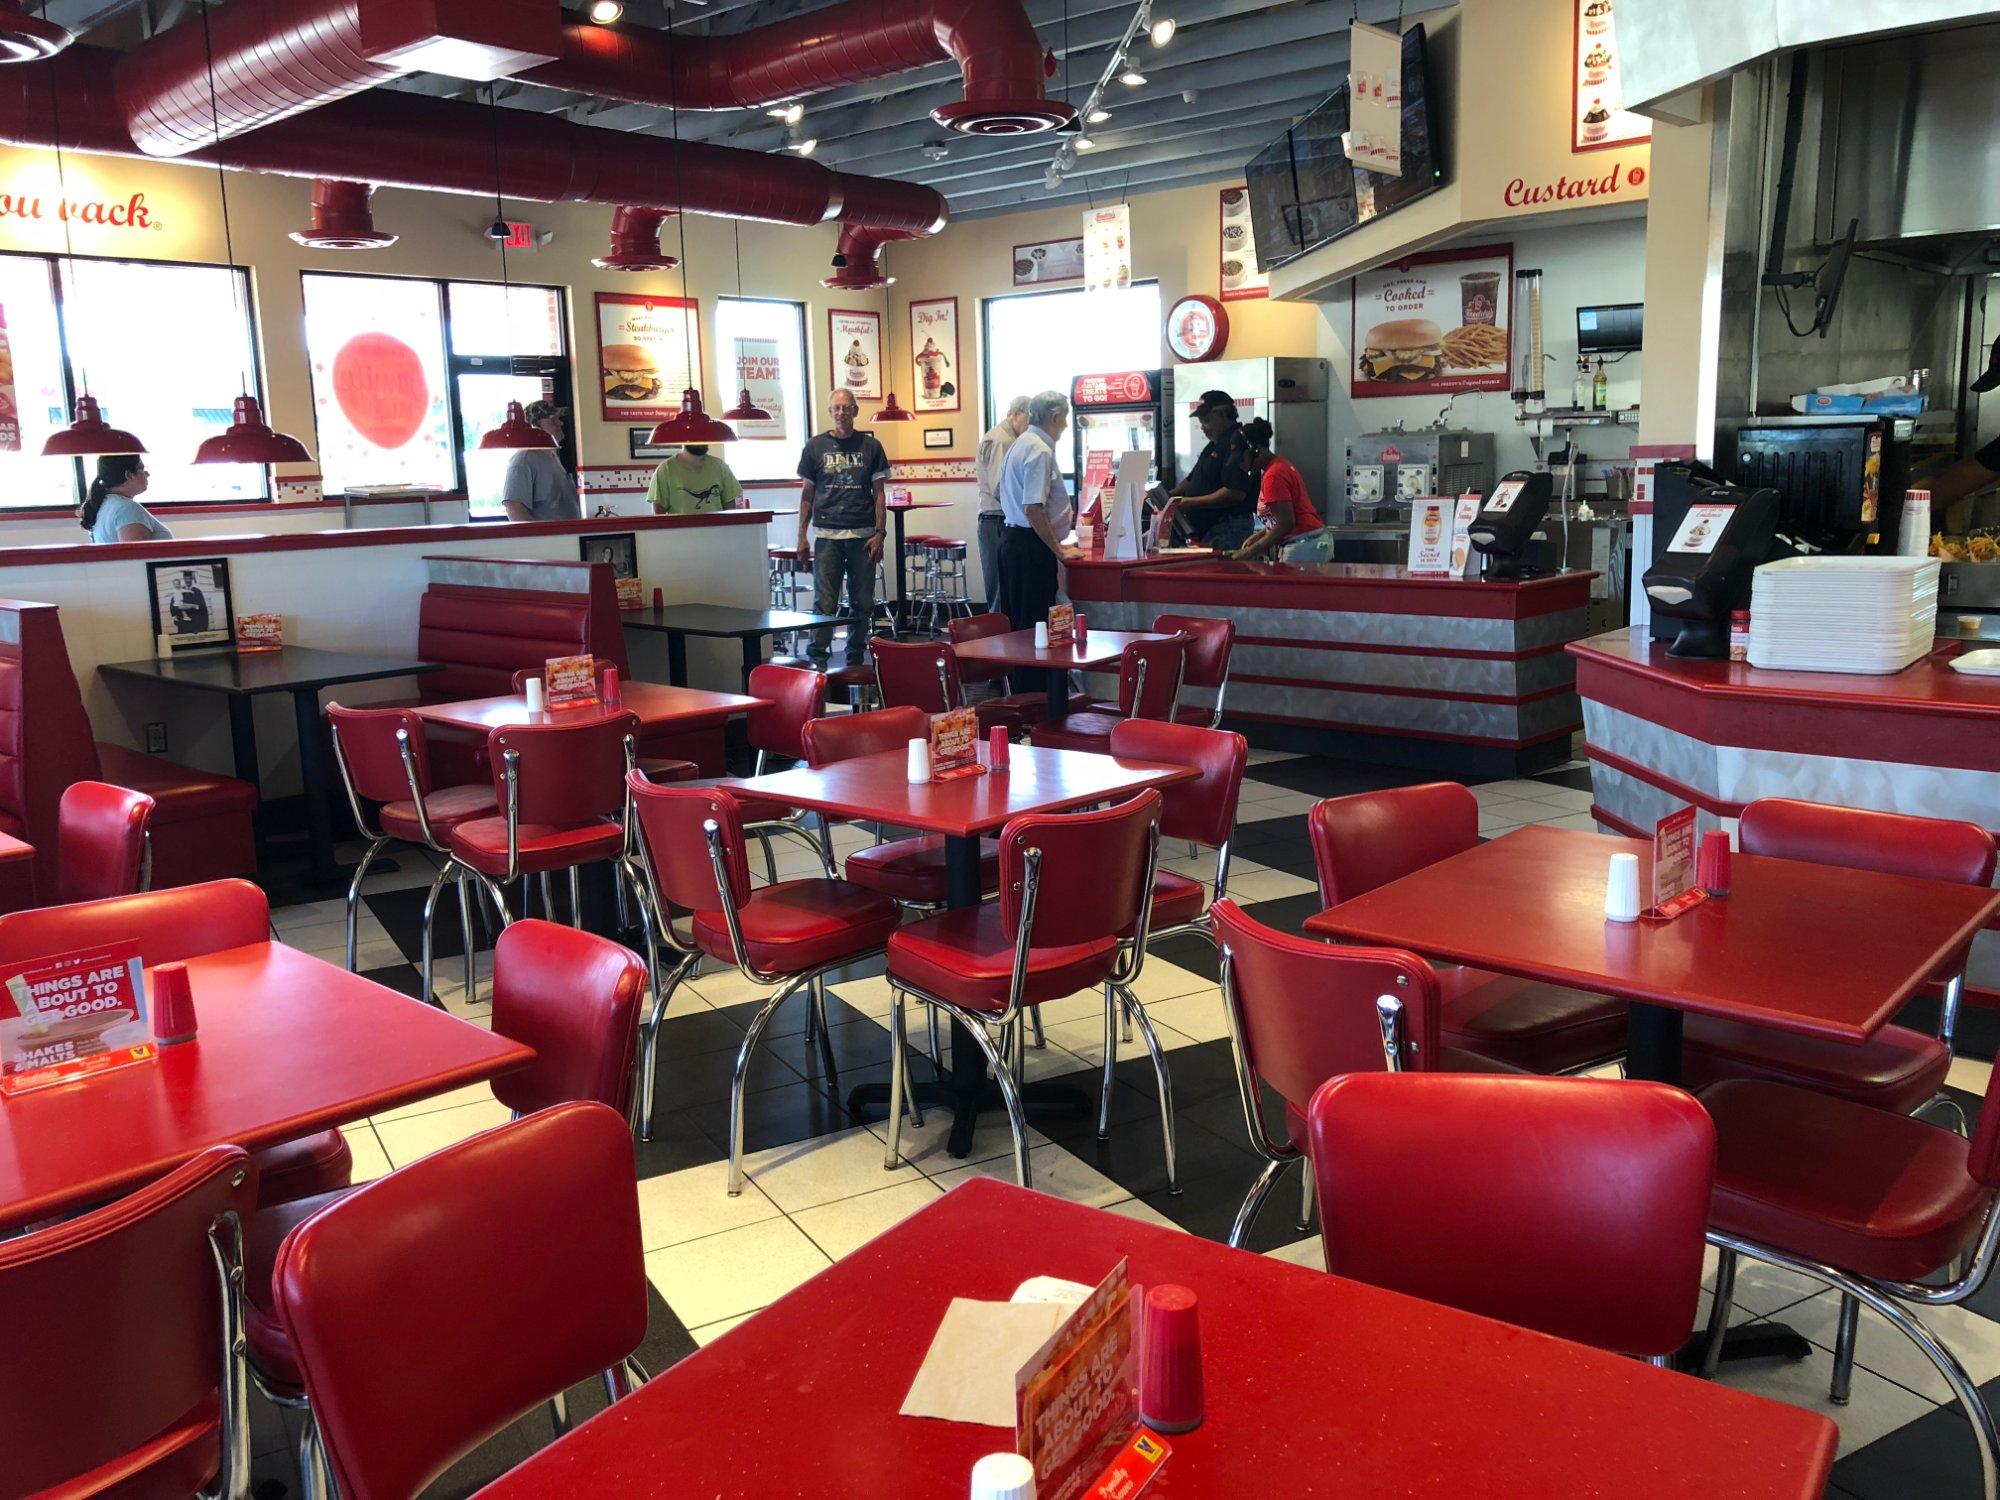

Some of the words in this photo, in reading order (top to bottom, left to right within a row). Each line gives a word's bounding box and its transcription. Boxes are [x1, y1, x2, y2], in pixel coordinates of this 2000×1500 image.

[1504, 163, 1621, 207] Custard
[1383, 285, 1426, 302] Cooked
[917, 311, 933, 326] Dig
[1397, 303, 1424, 311] ORDER
[736, 356, 758, 366] JOIN
[760, 357, 780, 366] OUR
[736, 366, 781, 380] TEAM!
[1083, 395, 1093, 403] TO
[15, 975, 83, 999] THINGS
[87, 965, 125, 985] ARE
[25, 987, 89, 1012] ABOUT
[93, 981, 119, 996] TO
[64, 995, 123, 1018] GOOD.
[14, 1040, 75, 1061] SHAKES
[14, 1062, 26, 1073] &
[27, 1050, 76, 1070] MALTS
[1035, 1366, 1090, 1436] THINGS
[1090, 1332, 1119, 1377] ARE
[1043, 1386, 1094, 1453] ABOUT
[1094, 1362, 1114, 1392] TO
[1041, 1435, 1071, 1481] GET
[1073, 1390, 1116, 1447] GOOD.
